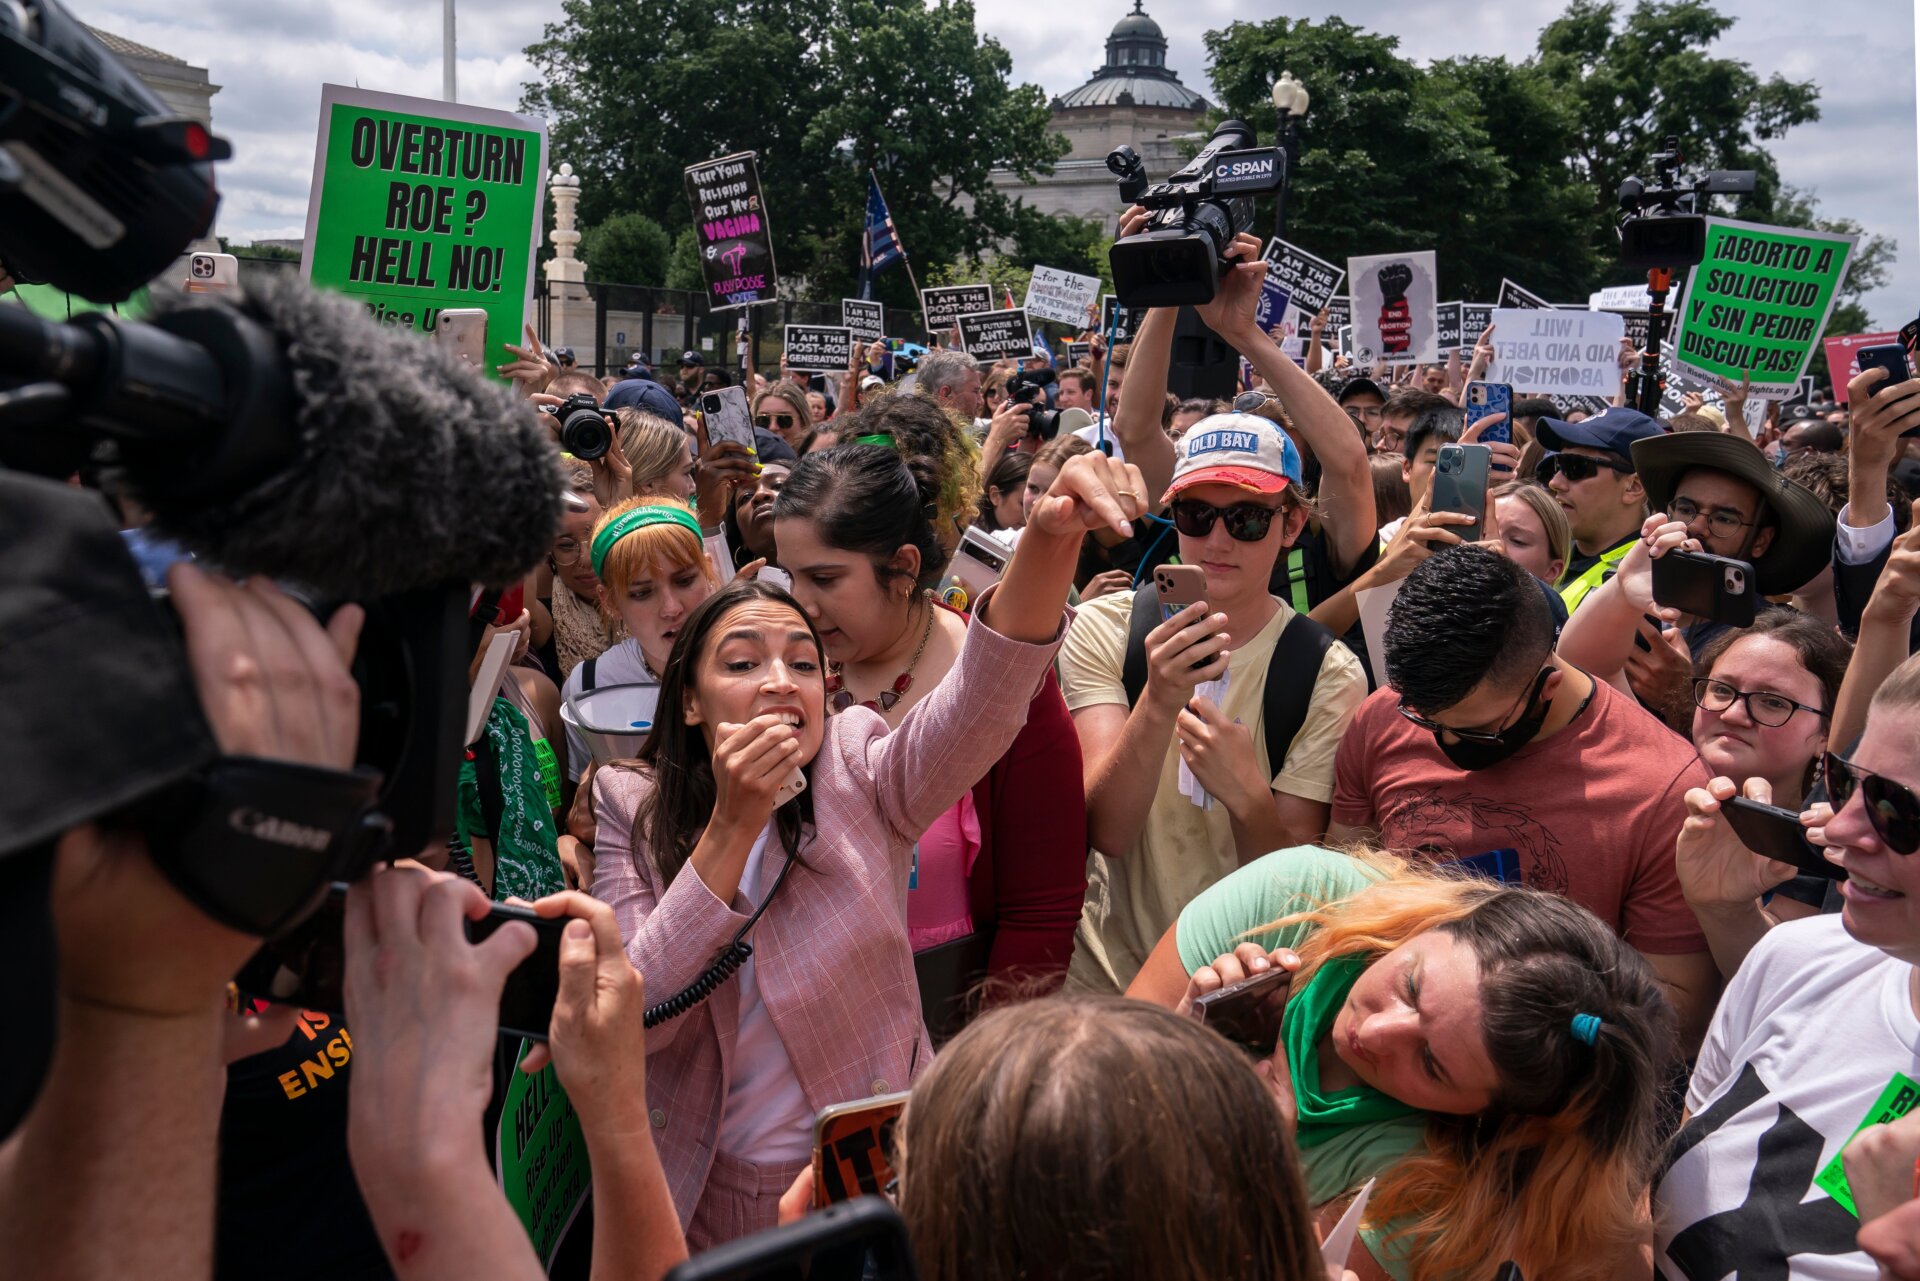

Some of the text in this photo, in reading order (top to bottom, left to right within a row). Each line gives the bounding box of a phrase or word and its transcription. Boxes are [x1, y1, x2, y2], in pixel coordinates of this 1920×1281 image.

[351, 116, 525, 185] OVERTURN
[1217, 176, 1236, 184] CREATED
[698, 181, 748, 204] RELIGION
[385, 181, 487, 236] ROE ?
[704, 204, 730, 221] OUT
[703, 213, 760, 241] VAGINA
[349, 235, 505, 293] HELL NO!
[1272, 250, 1278, 259] I
[1281, 255, 1304, 271] AM
[1308, 267, 1334, 286] THE
[1813, 248, 1834, 274] A
[1064, 275, 1085, 290] the
[1266, 258, 1333, 299] POST-ROE
[1705, 268, 1820, 308] SOLICITUD
[927, 301, 990, 315] POST-ROE
[938, 295, 957, 303] AM
[961, 293, 986, 301] THE
[422, 307, 443, 333] U
[845, 316, 881, 329] POST-ROE
[851, 308, 863, 317] AM
[864, 310, 879, 319] THE
[1691, 298, 1816, 342] Y SIN PEDIR
[966, 324, 982, 333] THE
[983, 321, 1012, 332] FUTURE
[979, 330, 1013, 342] ANTI-
[1380, 322, 1411, 330] ABORTION
[788, 343, 849, 354] POST-ROE
[791, 334, 846, 344] I AM THE
[967, 338, 1030, 354] ABORTION
[788, 354, 848, 365] GENERATION
[1683, 330, 1803, 374] DISCULPAS!
[1191, 432, 1251, 453] OLD BAY
[612, 506, 678, 537] #Green4Abortion
[228, 804, 333, 852] Canon
[525, 1143, 547, 1202] Rise
[531, 1138, 574, 1238] Abortion
